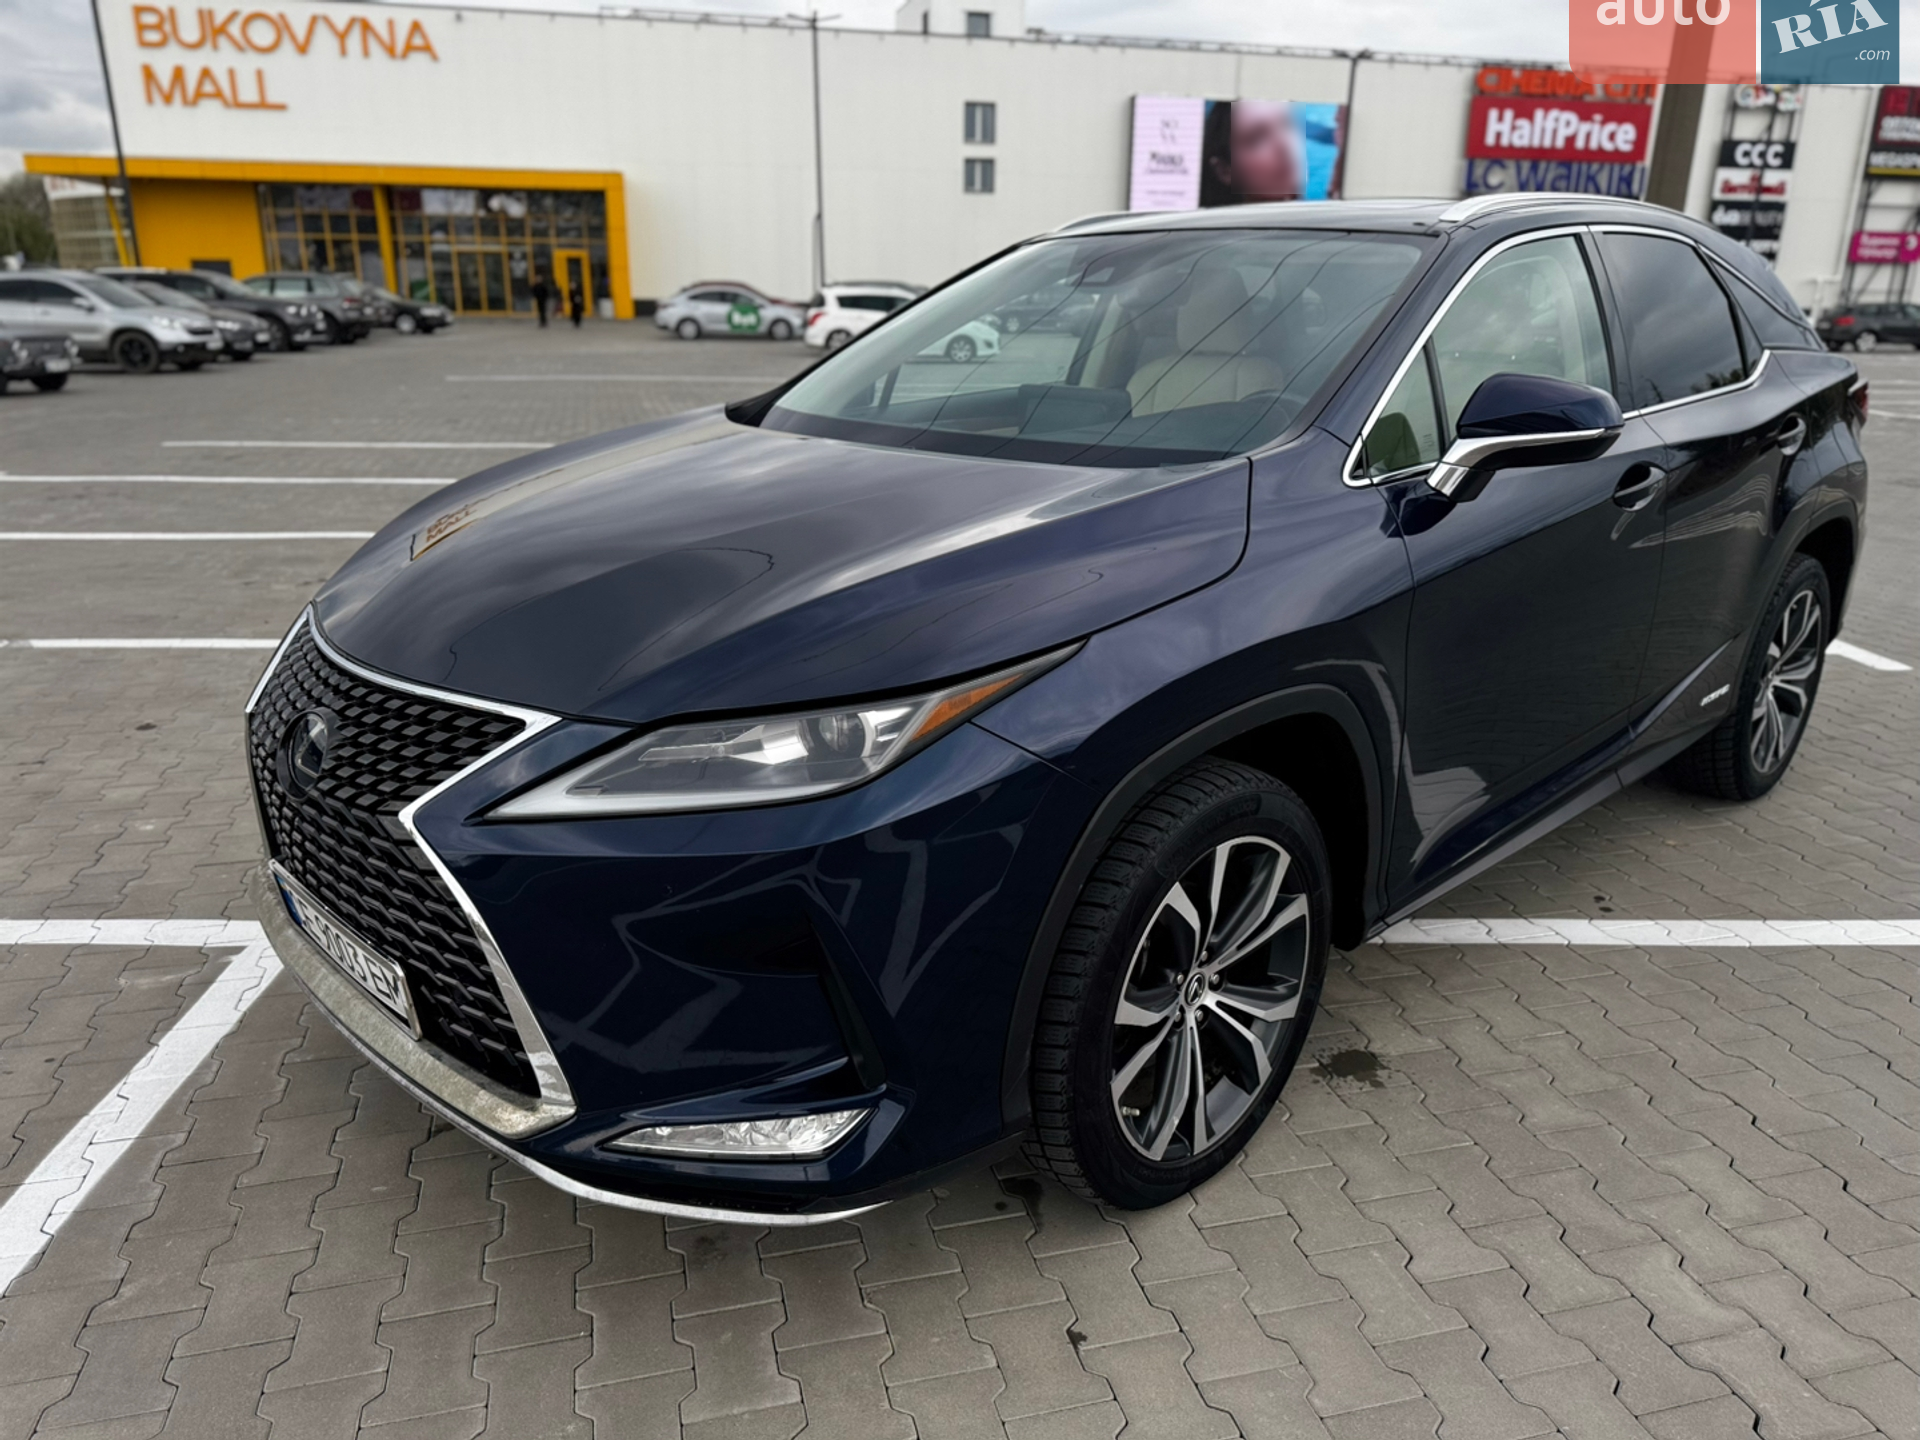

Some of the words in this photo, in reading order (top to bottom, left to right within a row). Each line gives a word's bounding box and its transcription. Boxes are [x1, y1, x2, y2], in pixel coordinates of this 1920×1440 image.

[132, 4, 439, 62] BUKOVYNA
[141, 63, 288, 111] MALL
[1484, 107, 1637, 153] HalfPrice
[1734, 142, 1785, 168] CCC
